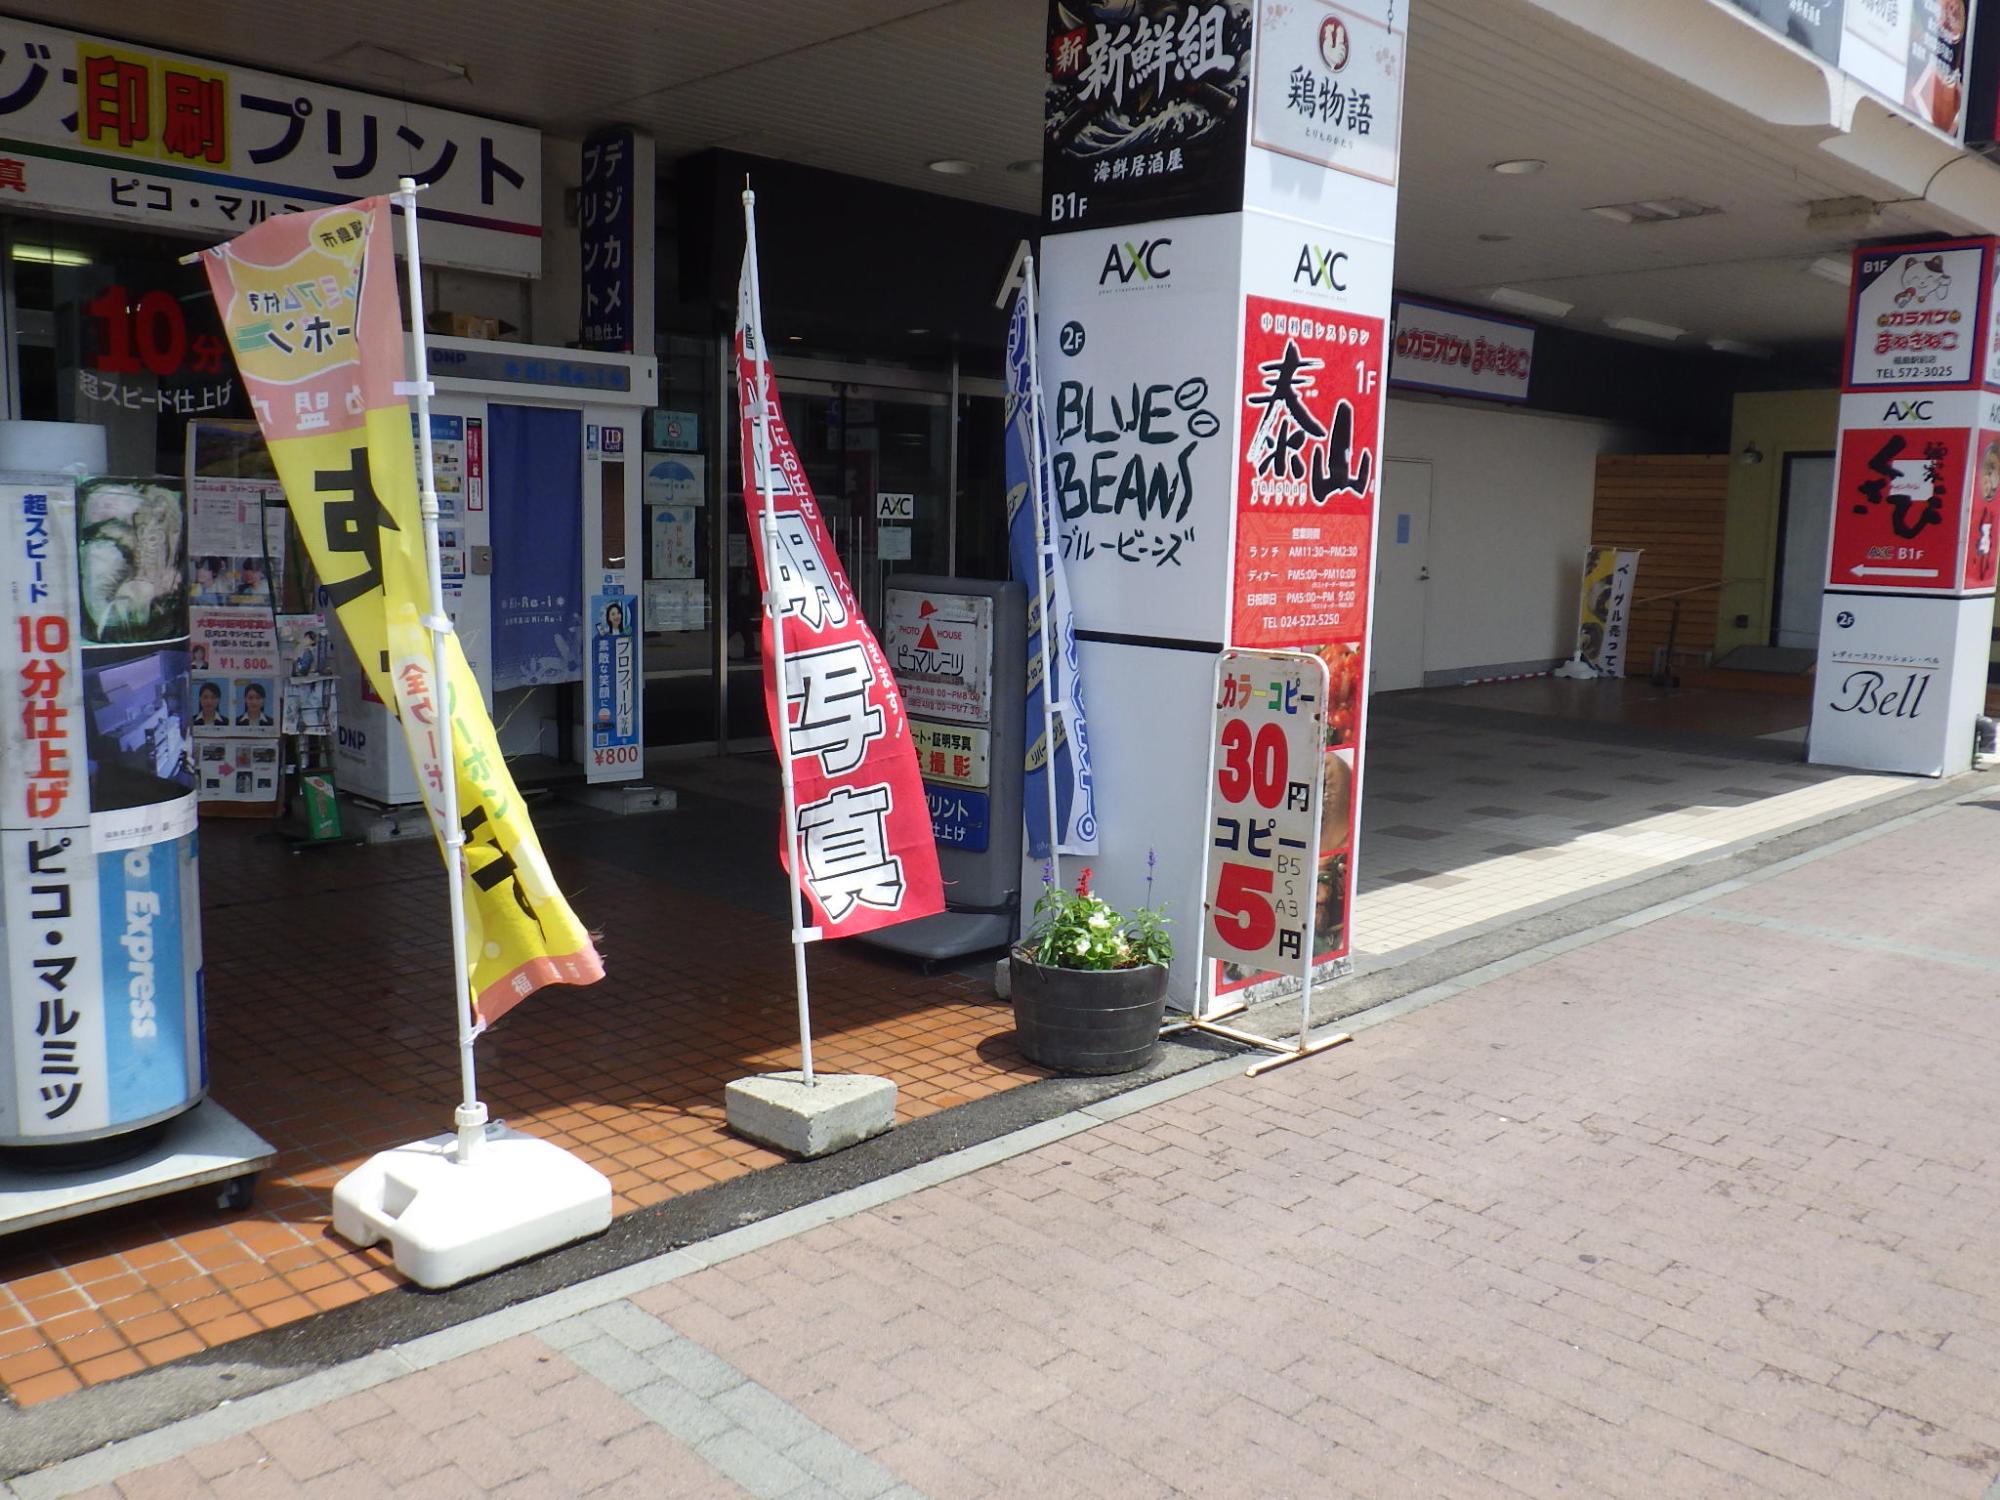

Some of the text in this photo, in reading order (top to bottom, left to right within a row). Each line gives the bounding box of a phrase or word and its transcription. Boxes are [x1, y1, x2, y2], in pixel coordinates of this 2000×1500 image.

[1076, 5, 1236, 108] 新鮮組
[1287, 64, 1373, 135] 鶏物語
[240, 97, 525, 206] プリント
[1093, 147, 1184, 183] 海鮮居酒屋
[1051, 191, 1088, 222] B1F
[603, 139, 623, 315] デジカメ
[1098, 238, 1172, 286] AXC
[1293, 243, 1349, 292] AXC
[1863, 260, 1888, 274] B1F
[1261, 312, 1370, 346] 中国料理レストラン
[1889, 310, 1949, 327] カラオケ
[1063, 327, 1083, 350] 2F
[1874, 329, 1960, 355] まねきねこ
[1355, 360, 1377, 394] 1F
[1876, 365, 1952, 378] TEL 572-3025
[79, 369, 233, 413] 超スピード仕上げ
[1056, 381, 1179, 445] BLUE
[1883, 400, 1934, 421] AXC
[605, 429, 621, 443] ID
[1053, 441, 1198, 523] BEANS
[880, 497, 911, 516] AXC
[24, 493, 48, 604] 超スピード
[1061, 525, 1195, 567] ブルービーンズ
[1250, 546, 1279, 558] ランチ
[1898, 547, 1925, 560] B1F
[1248, 569, 1279, 582] ディナー
[937, 629, 962, 640] HOUSE
[1263, 613, 1340, 629] TEL 024-522-5250
[1840, 613, 1855, 626] 2F
[1222, 672, 1315, 715] カラーコピー
[1830, 670, 1931, 718] Bell
[339, 725, 366, 750] DNP
[910, 729, 972, 751] ート・証明写真
[594, 746, 638, 766] ¥800
[915, 747, 971, 777] 撮影
[1214, 816, 1307, 859] コピー
[1277, 854, 1301, 876] B5
[1275, 899, 1299, 918] A3
[28, 837, 82, 1120] ピコ・マルミツ
[120, 890, 161, 1040] Express
